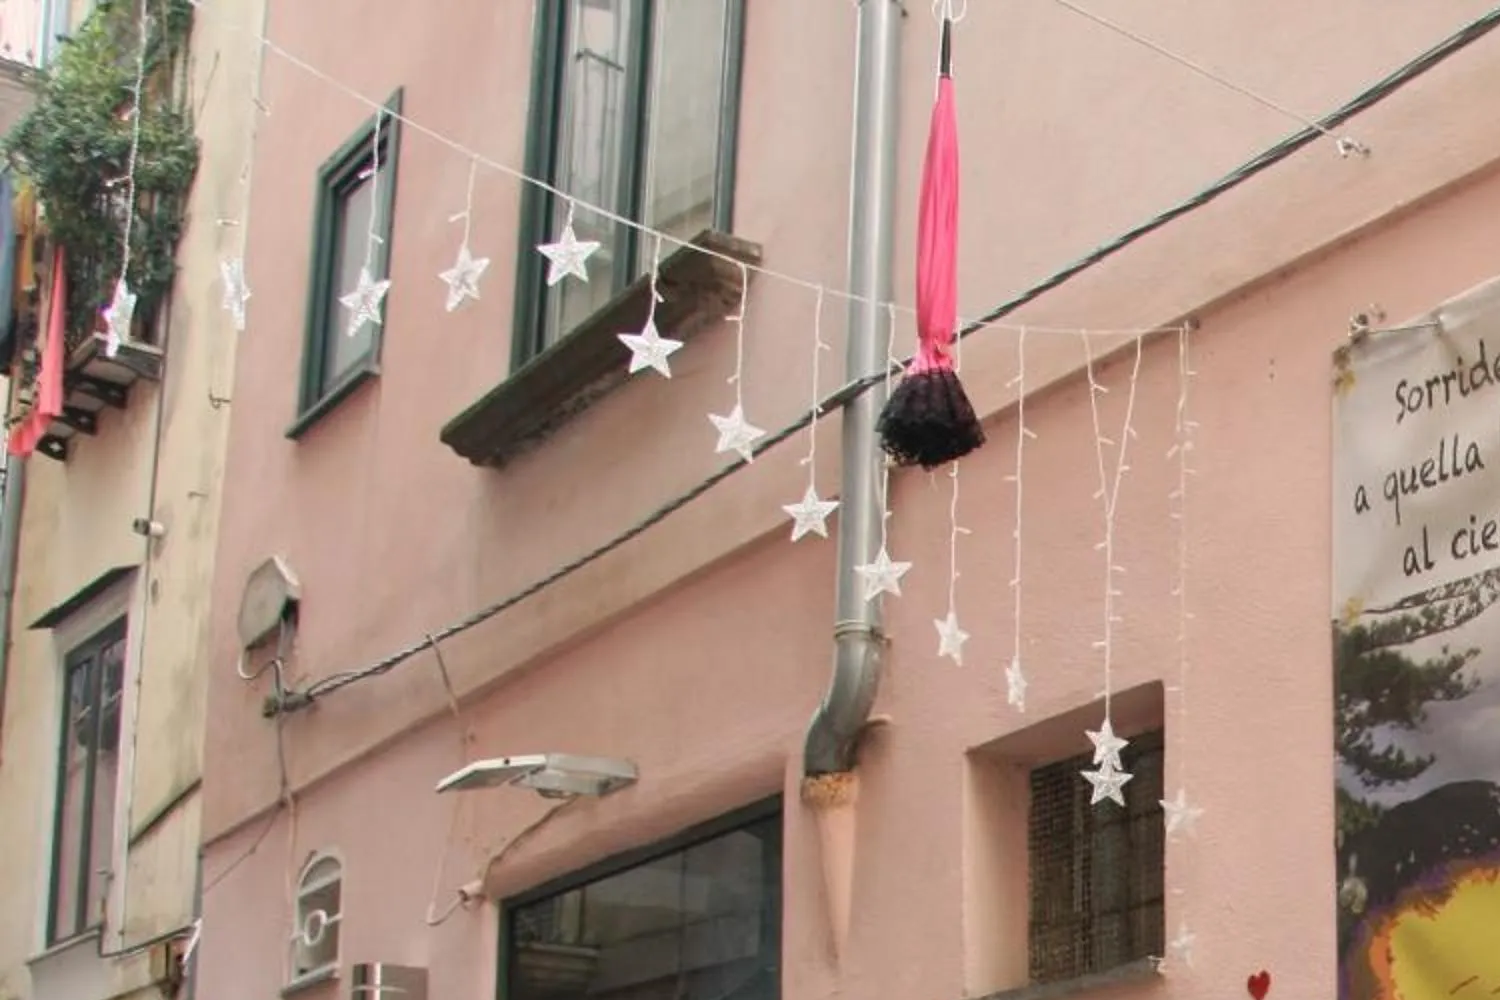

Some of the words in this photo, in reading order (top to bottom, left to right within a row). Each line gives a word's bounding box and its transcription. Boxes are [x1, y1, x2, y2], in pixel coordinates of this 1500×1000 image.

[1352, 480, 1370, 515] a
[1382, 433, 1485, 525] quella
[1402, 526, 1435, 577] al
